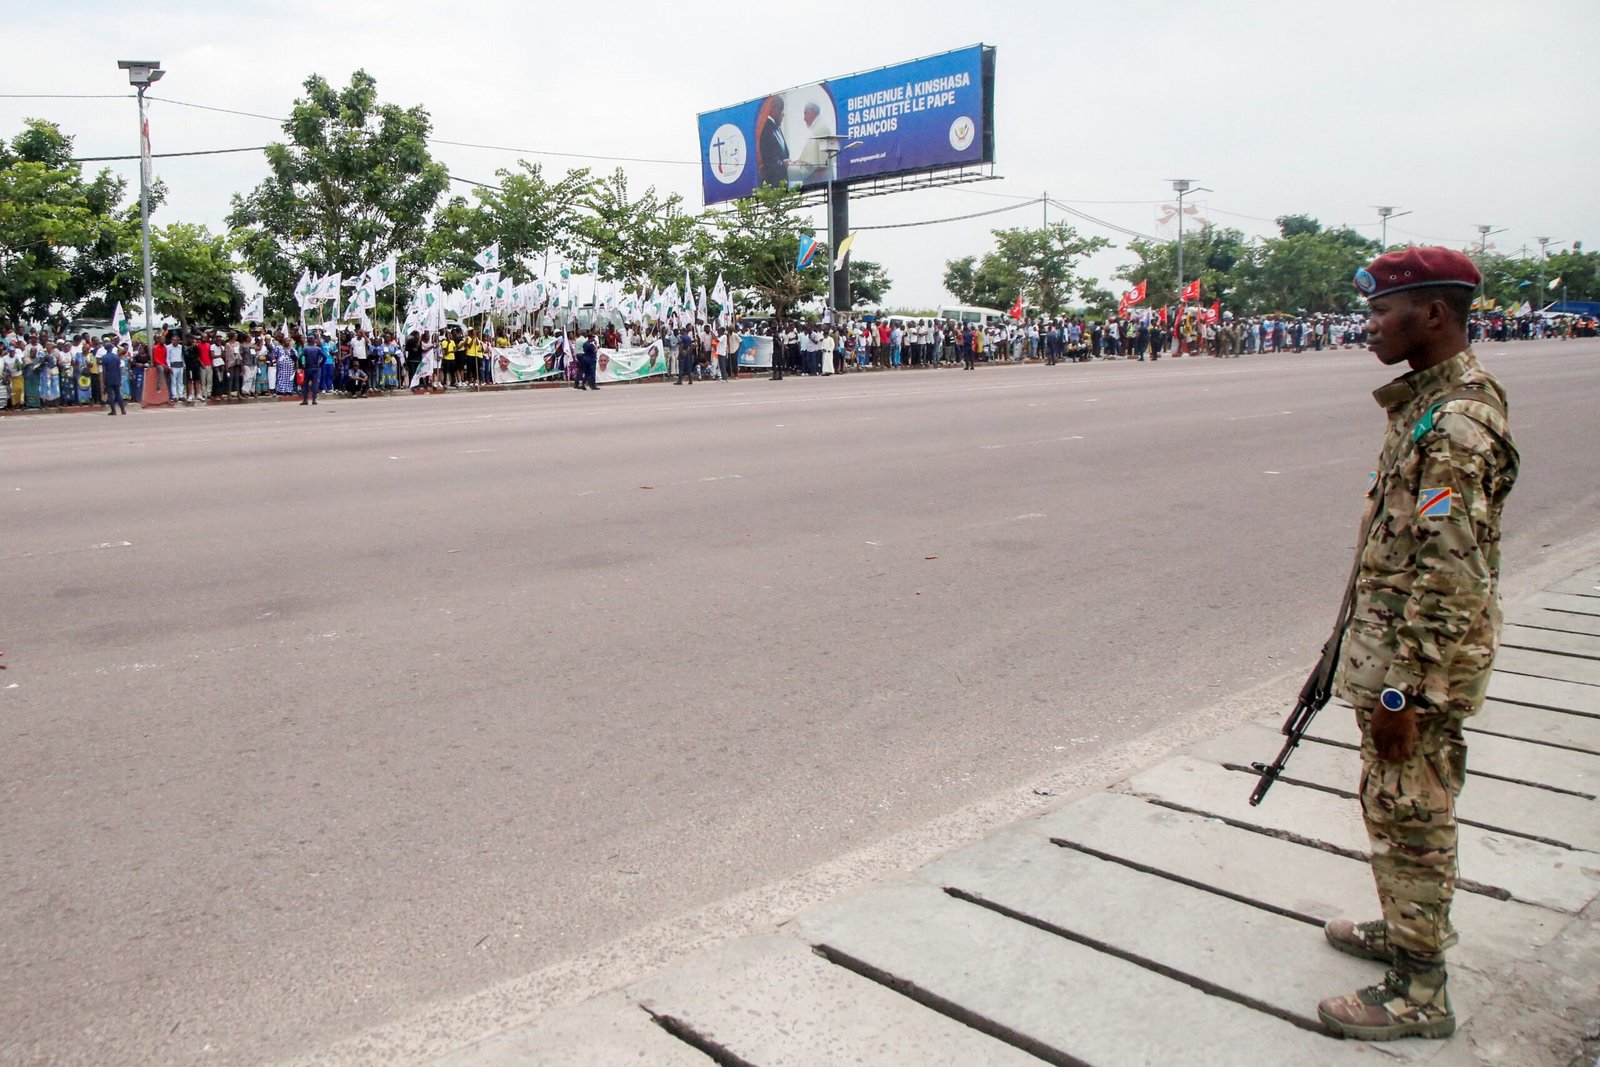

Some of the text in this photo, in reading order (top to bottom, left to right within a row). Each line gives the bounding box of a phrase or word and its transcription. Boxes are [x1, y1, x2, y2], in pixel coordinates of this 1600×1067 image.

[847, 72, 970, 111] BIENVENUE À KINSHASA
[847, 91, 956, 125] SA SAINTETÉ LE PAPE
[848, 118, 898, 140] FRANÇOIS
